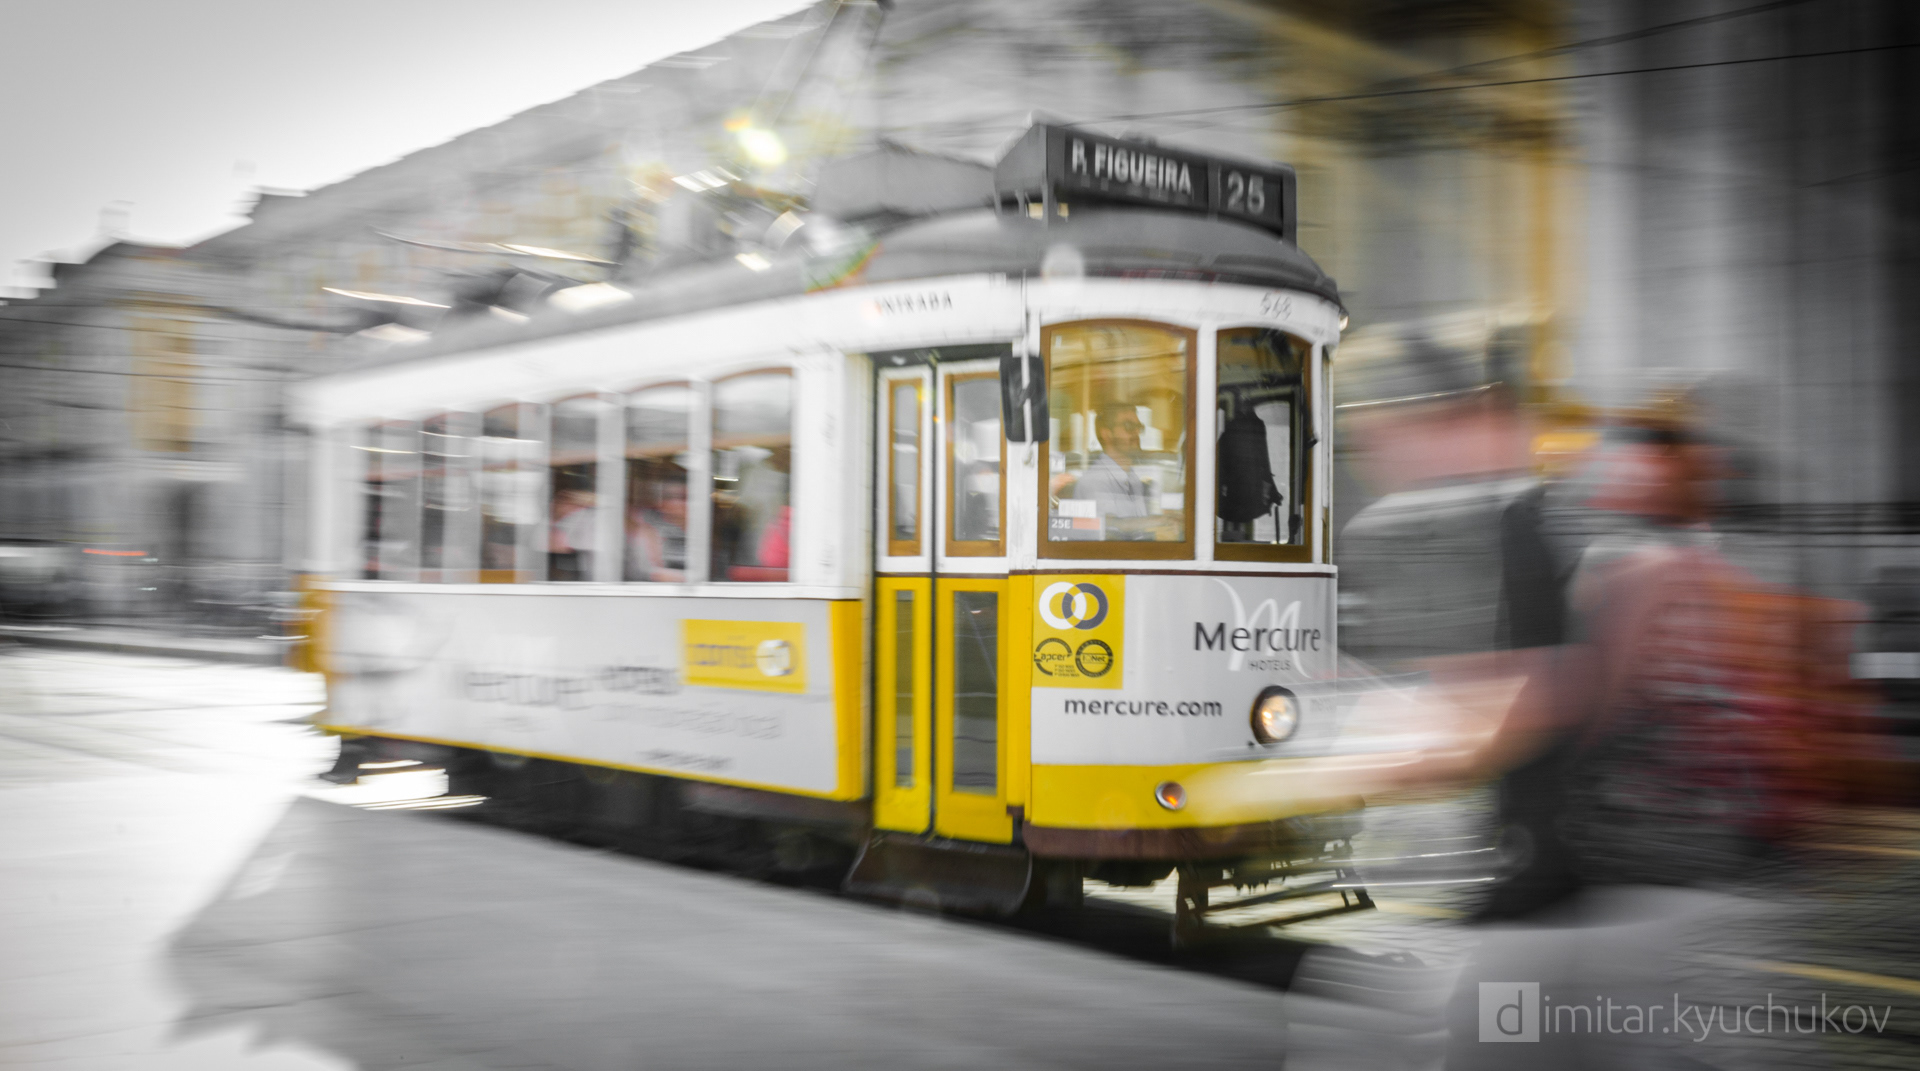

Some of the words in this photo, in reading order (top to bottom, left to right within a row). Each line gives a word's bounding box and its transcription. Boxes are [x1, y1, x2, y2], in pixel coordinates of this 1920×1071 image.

[1094, 144, 1193, 195] FIGUEIRA
[1226, 172, 1266, 216] 25
[1051, 518, 1071, 531] 25E
[1193, 621, 1322, 653] Mercure
[1248, 660, 1291, 672] HOTELS
[1064, 698, 1223, 718] mercure.com
